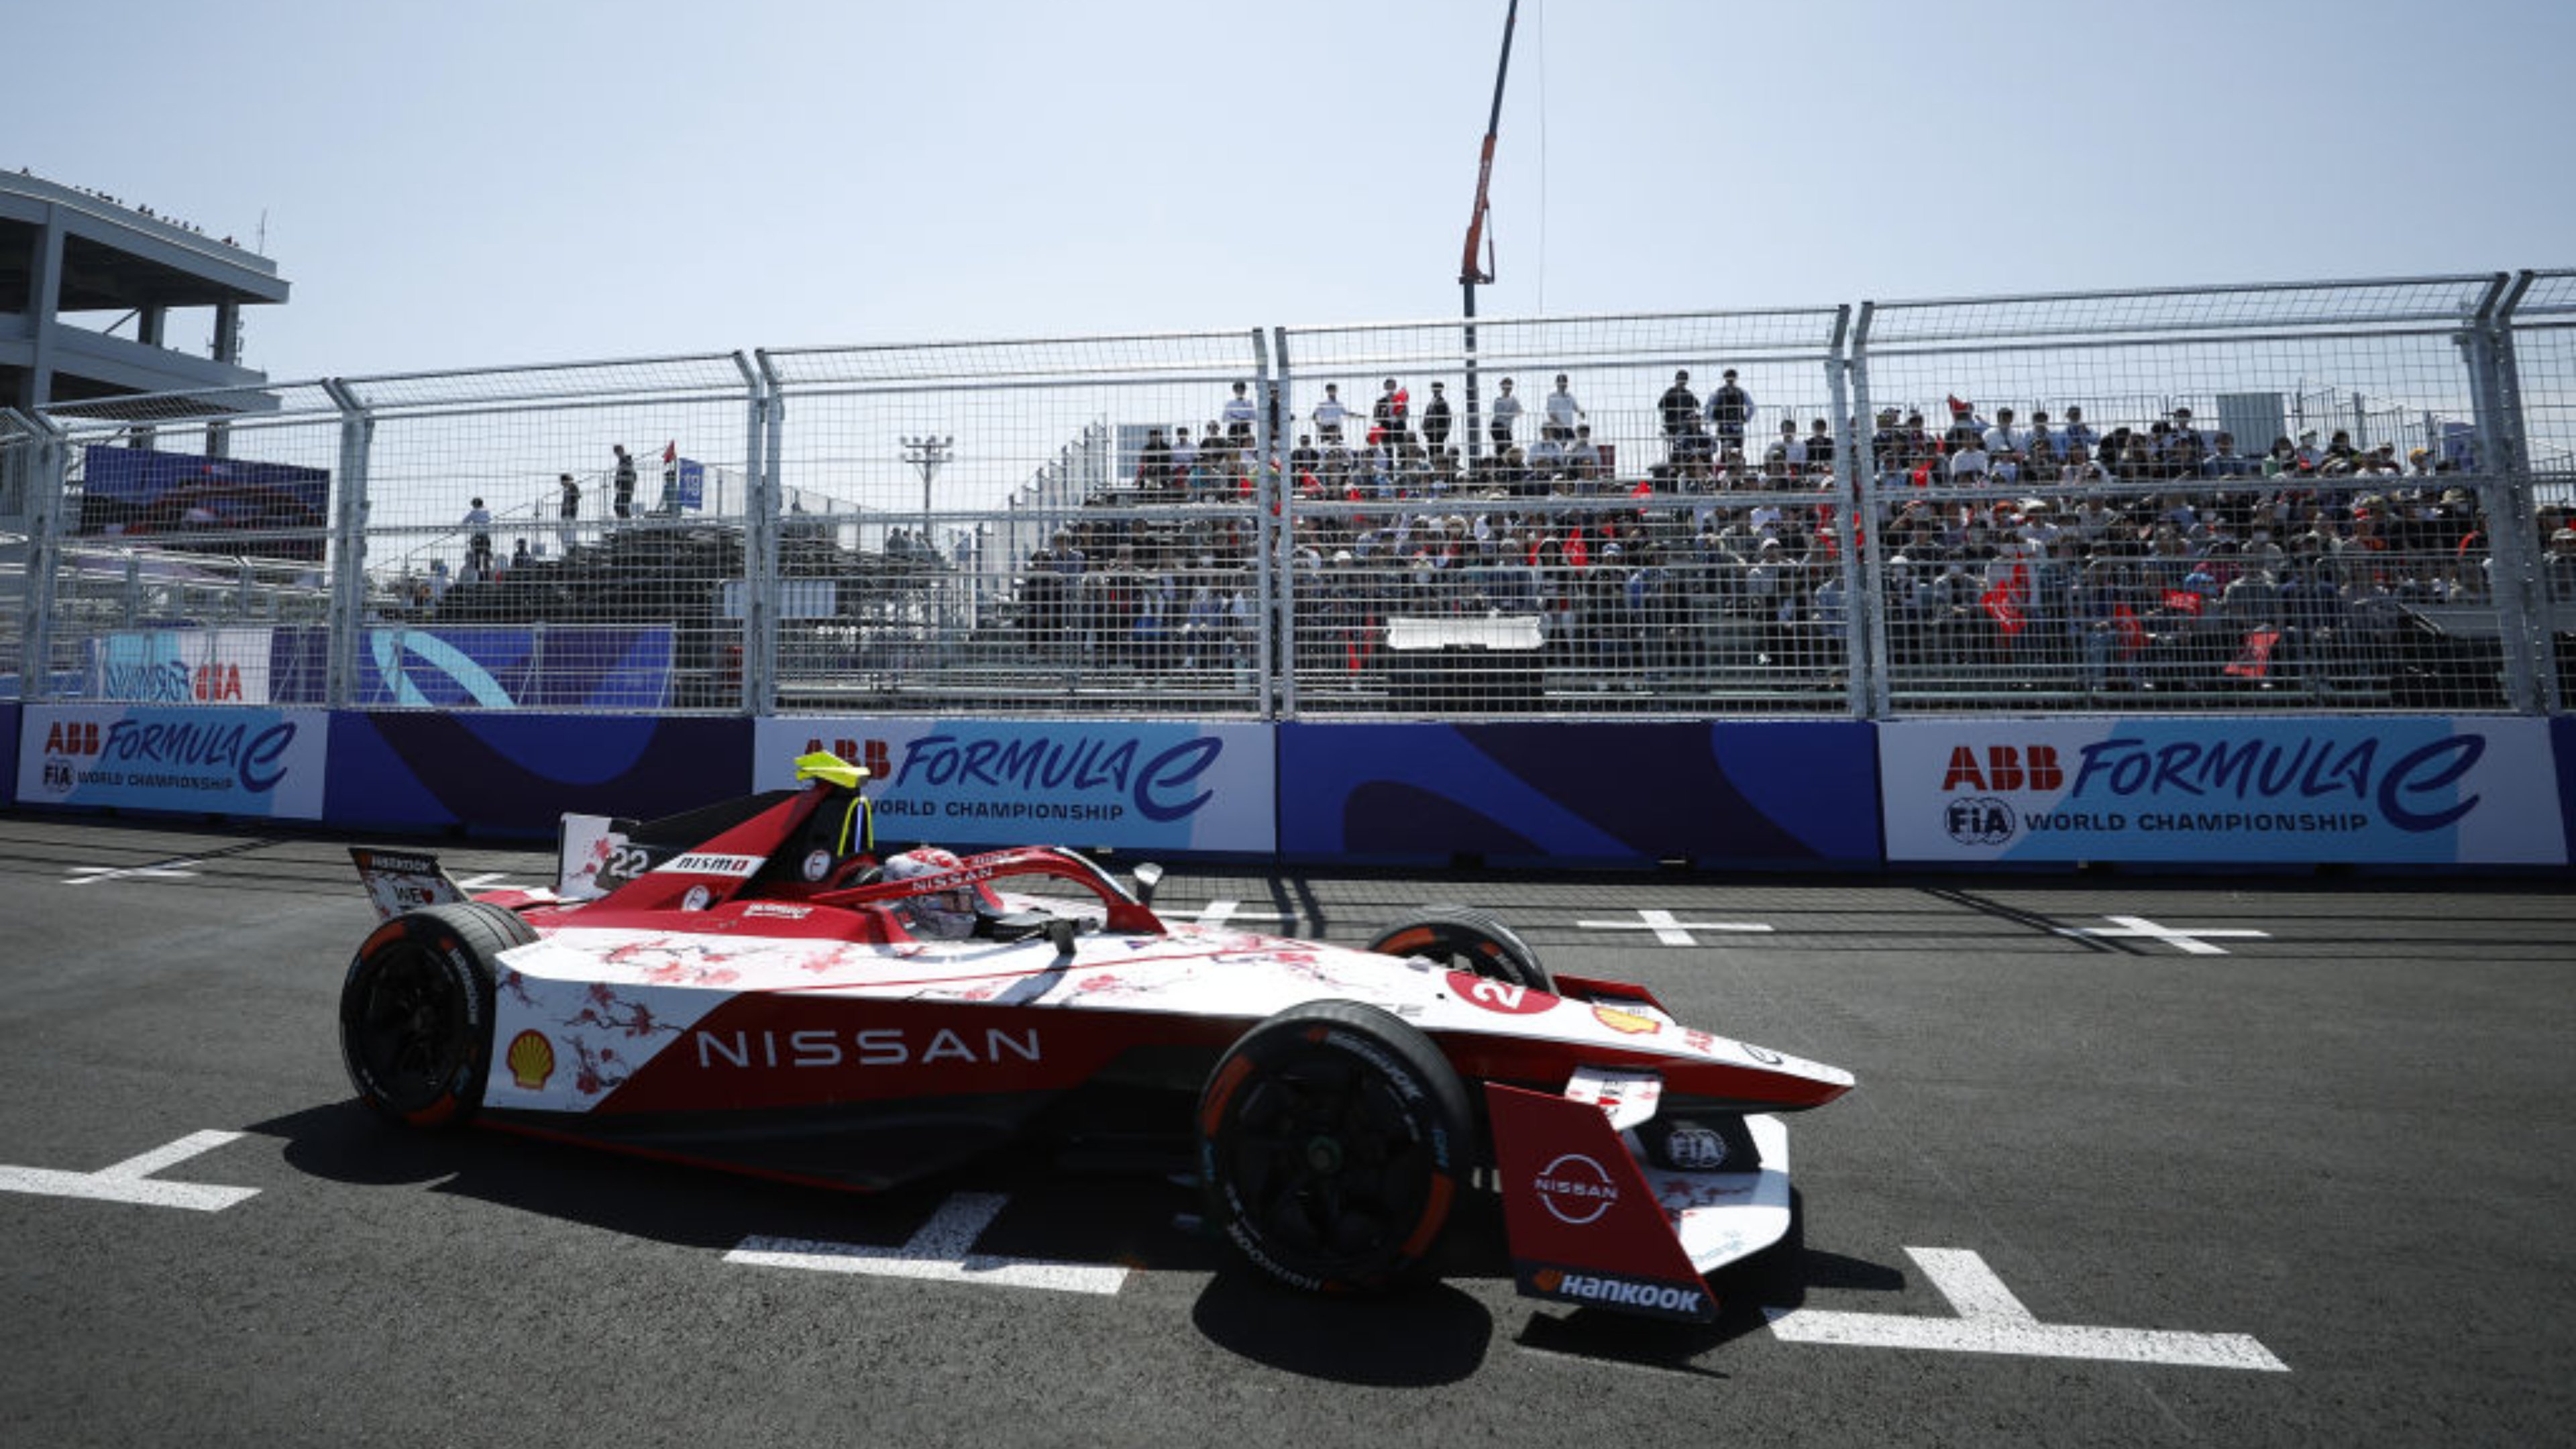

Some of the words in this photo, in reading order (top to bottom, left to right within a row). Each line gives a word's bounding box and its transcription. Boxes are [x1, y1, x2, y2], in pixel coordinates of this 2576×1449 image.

[44, 721, 99, 756] ABB
[101, 720, 246, 768] FORMULA
[44, 763, 72, 786] FIA
[78, 773, 123, 786] WORLD
[127, 773, 233, 790] CHAMPIONSHIP
[896, 736, 1139, 793] FORMULA
[1942, 746, 2063, 791] ABB
[2072, 738, 2378, 799] FORMULA
[945, 801, 1124, 821] CHAMPIONSHIP
[1949, 808, 2009, 834] FIA
[2025, 812, 2127, 831] WORLD
[2138, 813, 2368, 832] CHAMPIONSHIP
[610, 847, 649, 878] 22
[912, 867, 993, 891] NISSAN
[696, 1028, 1041, 1067] NISSAN
[1670, 1134, 1720, 1157] FIA
[1534, 1178, 1619, 1199] NISSAN
